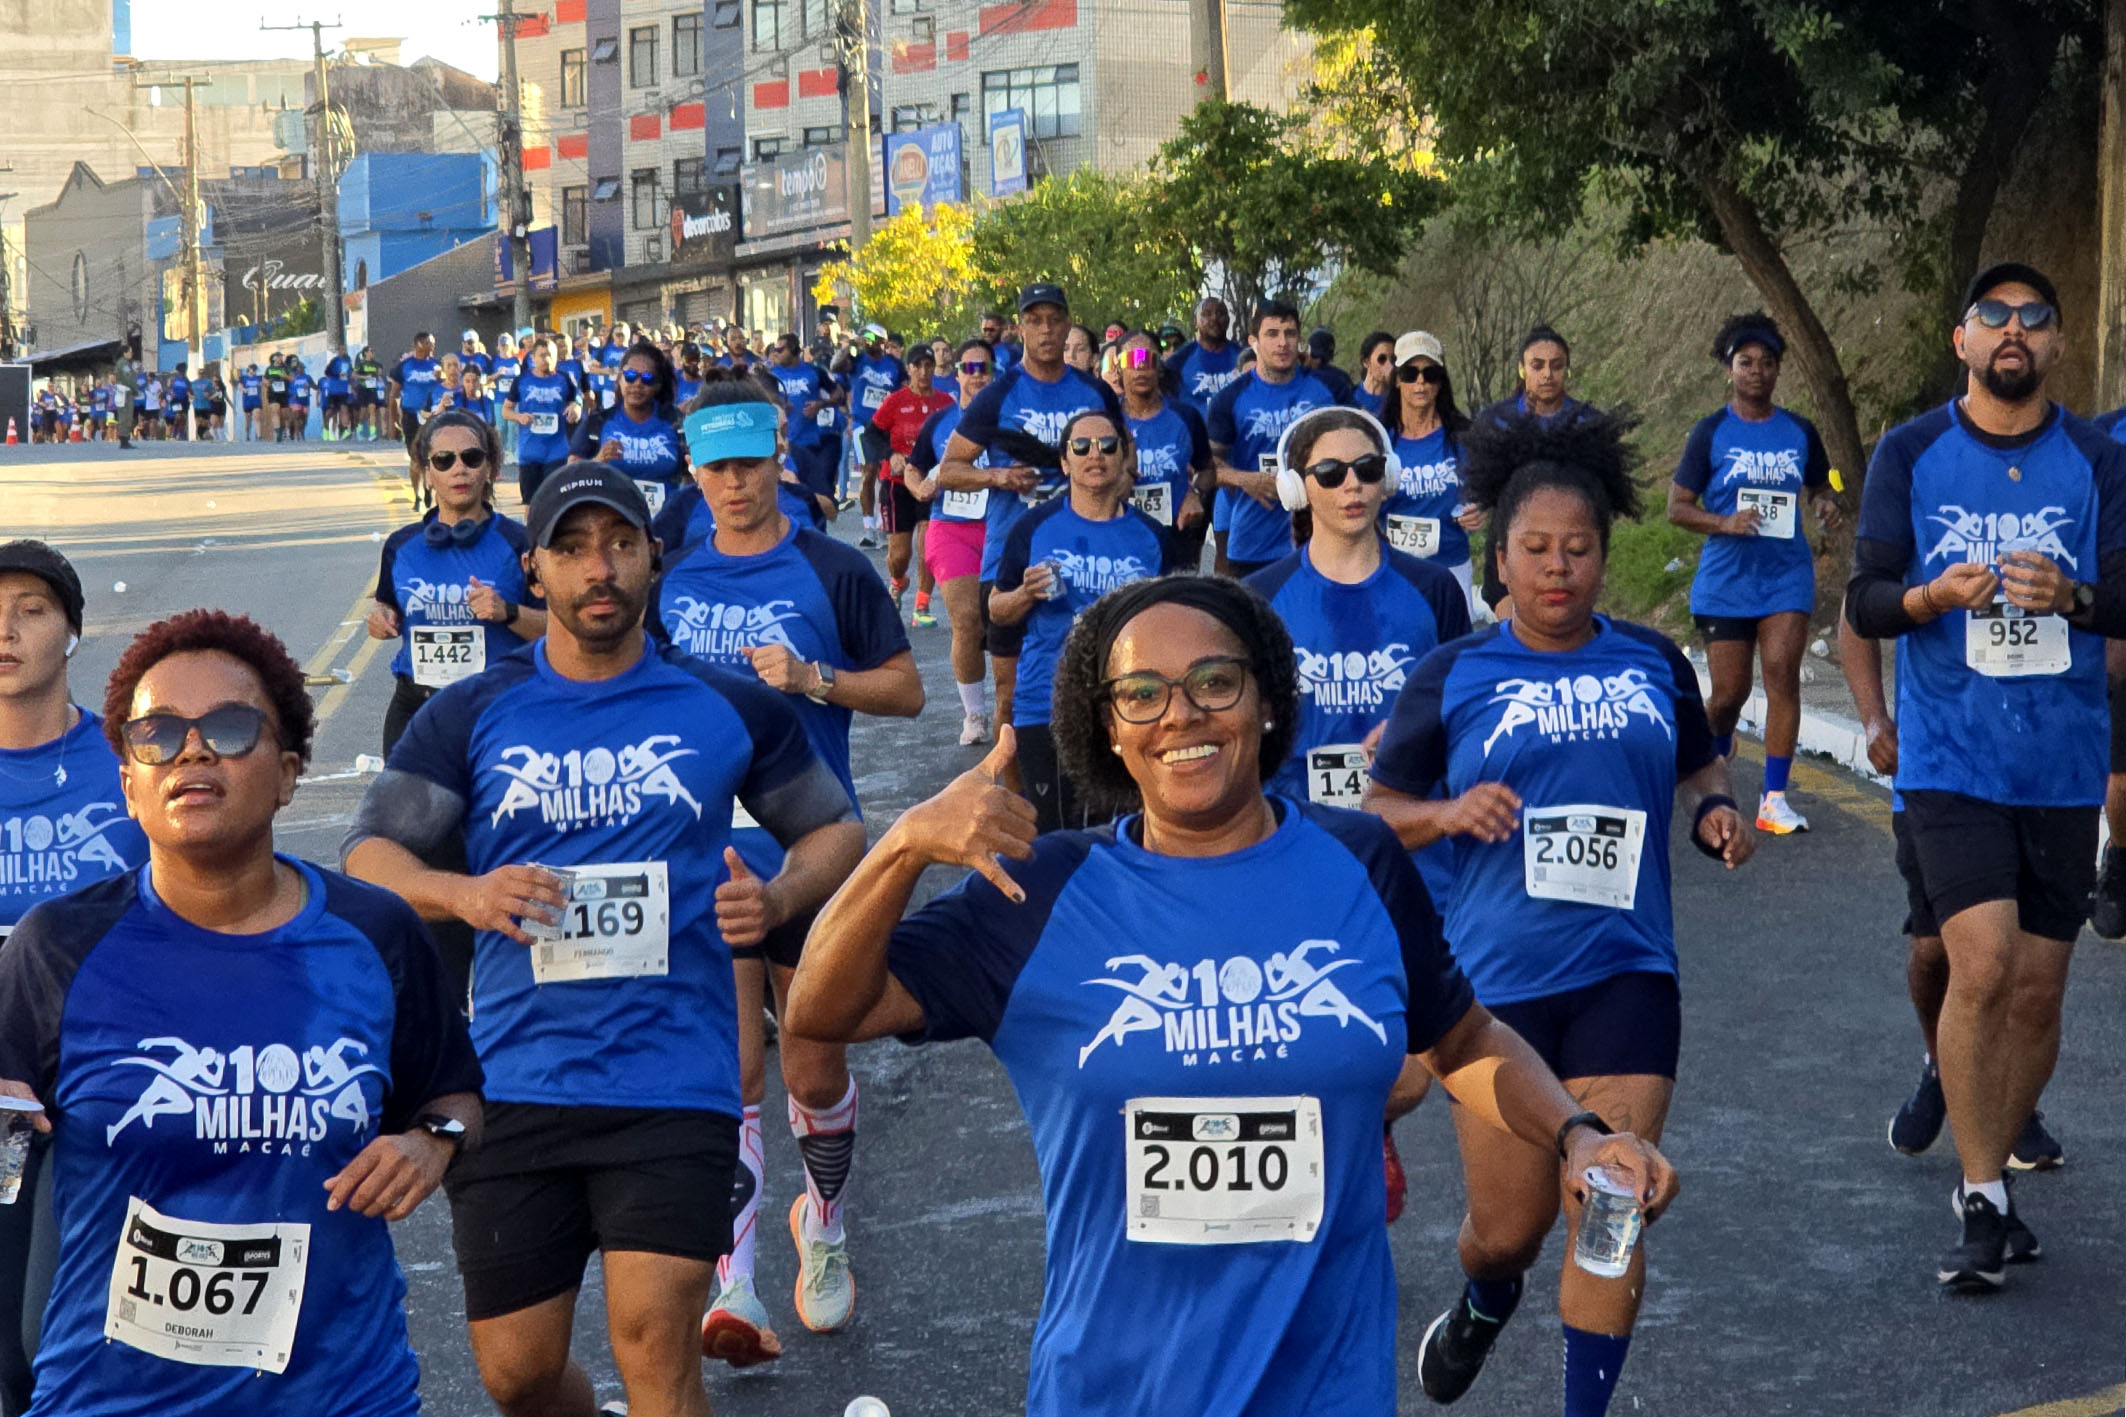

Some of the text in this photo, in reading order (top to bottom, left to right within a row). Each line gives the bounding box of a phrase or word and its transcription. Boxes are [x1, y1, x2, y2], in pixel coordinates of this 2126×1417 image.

[931, 131, 954, 152] AUTO
[1405, 478, 1447, 497] MILHAS
[1390, 530, 1428, 548] 1.793
[1985, 513, 2020, 542] 10
[1086, 555, 1112, 575] 10
[1967, 540, 1998, 565] MIL
[437, 584, 462, 604] 10
[424, 603, 475, 620] MILHAS
[710, 603, 746, 631] 10
[1989, 619, 2038, 646] 952
[418, 645, 472, 663] 1.442
[1329, 651, 1367, 682] 10
[1313, 680, 1384, 707] MILHAS
[1555, 675, 1603, 706] 10
[1536, 700, 1629, 735] MILHAS
[562, 747, 616, 788] 10
[1320, 768, 1370, 797] 1.4
[540, 781, 642, 824] MILHAS
[4, 814, 54, 853] 10
[1536, 835, 1618, 871] 2.056
[544, 900, 644, 942] .169
[1192, 956, 1263, 1007] 10
[1164, 1001, 1301, 1052] MILHAS
[229, 1043, 300, 1094] 10
[1182, 1044, 1289, 1066] MACAÉ
[195, 1093, 332, 1142] MILHAS
[213, 1140, 312, 1157] MACAÉ
[1143, 1144, 1289, 1192] 2.010
[127, 1255, 270, 1316] 1.067
[164, 1321, 214, 1339] DEBORAH
